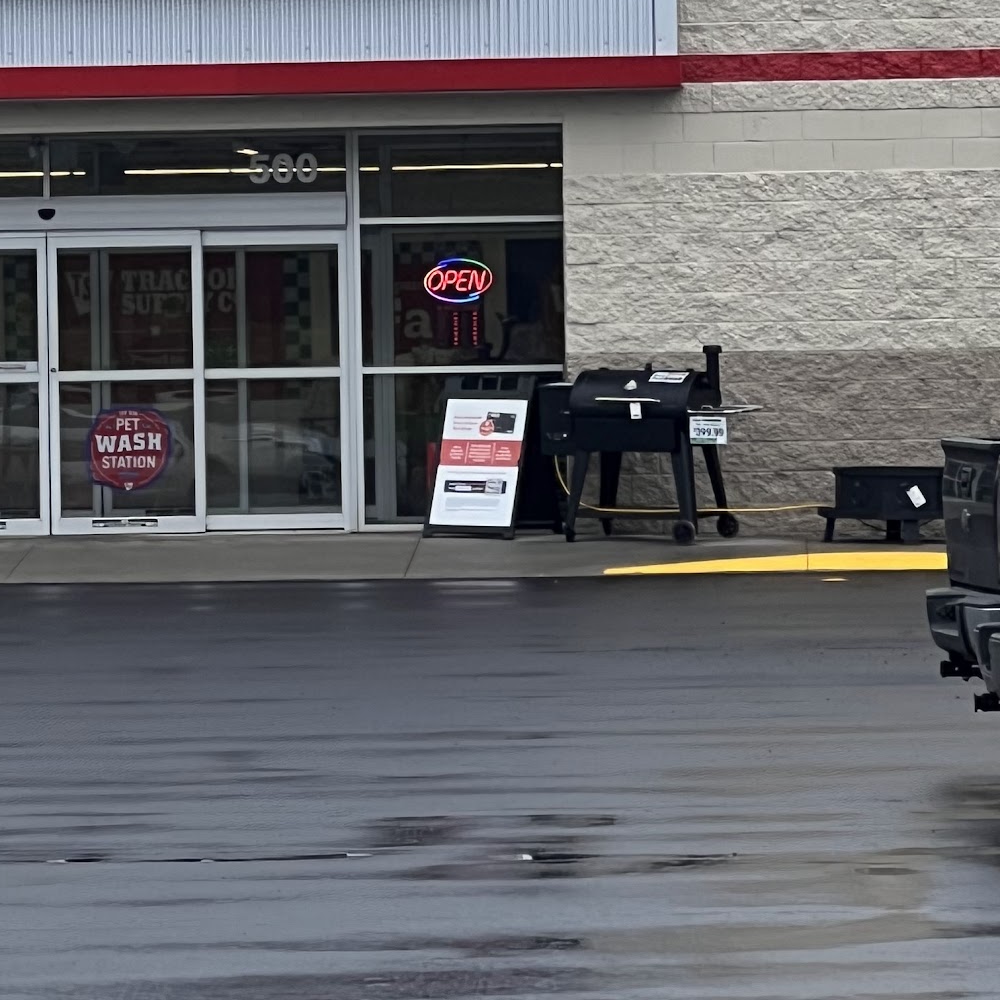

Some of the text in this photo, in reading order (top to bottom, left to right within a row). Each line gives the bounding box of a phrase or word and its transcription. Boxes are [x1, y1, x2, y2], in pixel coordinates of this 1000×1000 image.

[249, 153, 317, 184] 500
[428, 270, 486, 291] OPEN
[116, 418, 141, 431] PET
[95, 432, 162, 453] WASH
[102, 455, 156, 469] STATION
